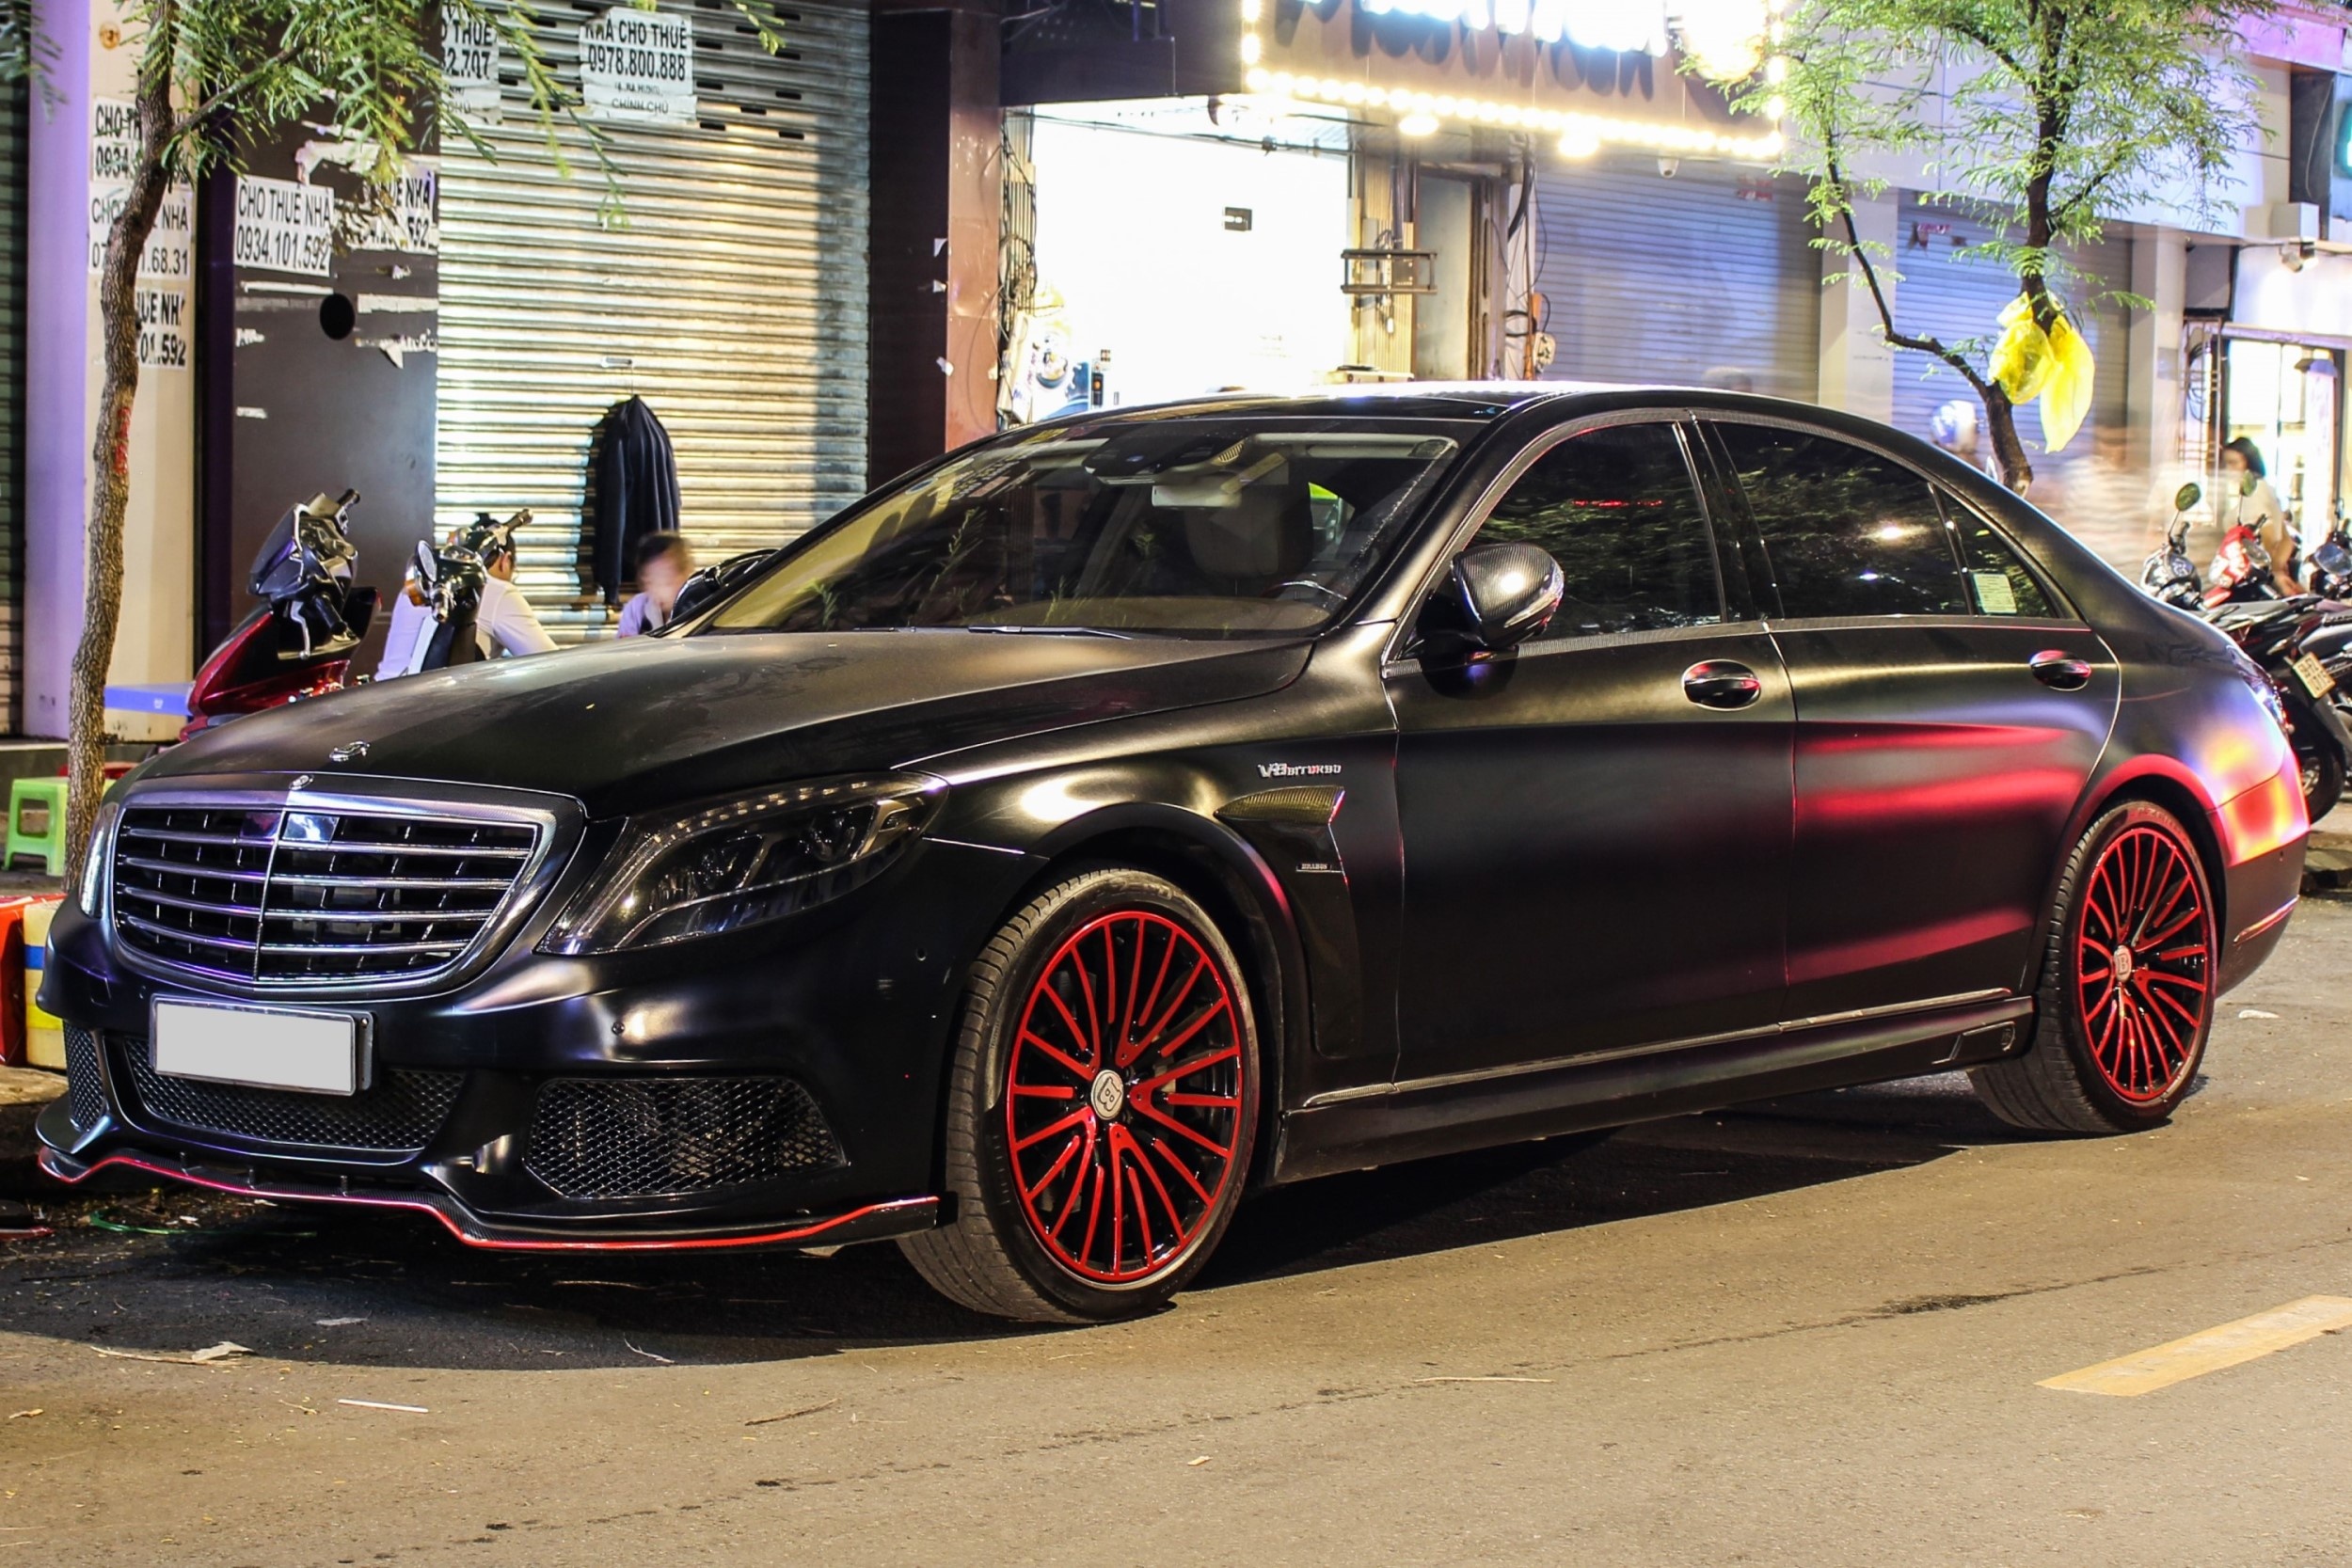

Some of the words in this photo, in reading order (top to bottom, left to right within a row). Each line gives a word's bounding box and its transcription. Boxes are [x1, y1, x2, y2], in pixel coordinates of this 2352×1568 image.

[618, 20, 647, 44] CHO
[650, 21, 688, 49] THUÊ
[588, 44, 686, 82] 0978.800.888
[95, 104, 122, 137] CHO
[162, 198, 189, 231] NHÀ
[238, 184, 265, 219] CHO
[269, 183, 301, 225] THUÊ
[305, 187, 331, 229] NHÀ
[236, 224, 329, 271] 0934.101.592
